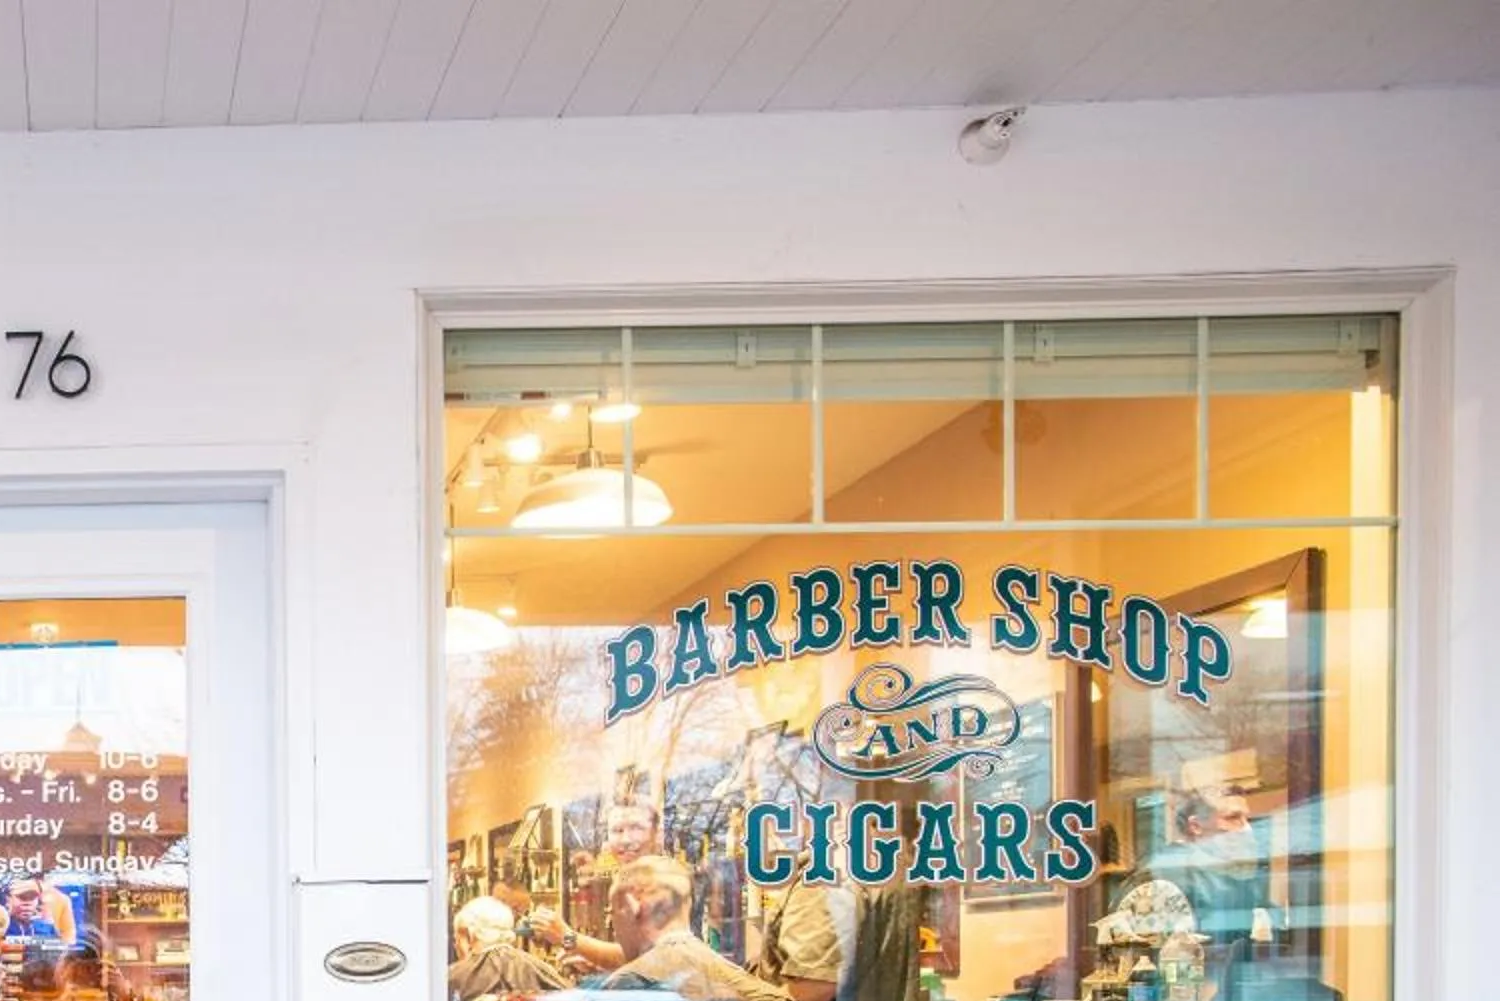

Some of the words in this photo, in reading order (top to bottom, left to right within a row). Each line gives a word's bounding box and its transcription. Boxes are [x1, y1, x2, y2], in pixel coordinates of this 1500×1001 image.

[5, 330, 91, 399] 76
[604, 559, 971, 726] BARBER
[990, 564, 1234, 706] SHOP
[855, 703, 990, 760] AND
[41, 780, 82, 804] Fri.
[108, 779, 159, 803] 8-6
[108, 811, 159, 835] 8-4
[743, 799, 1099, 886] CIGARS
[55, 849, 156, 875] Sunday
